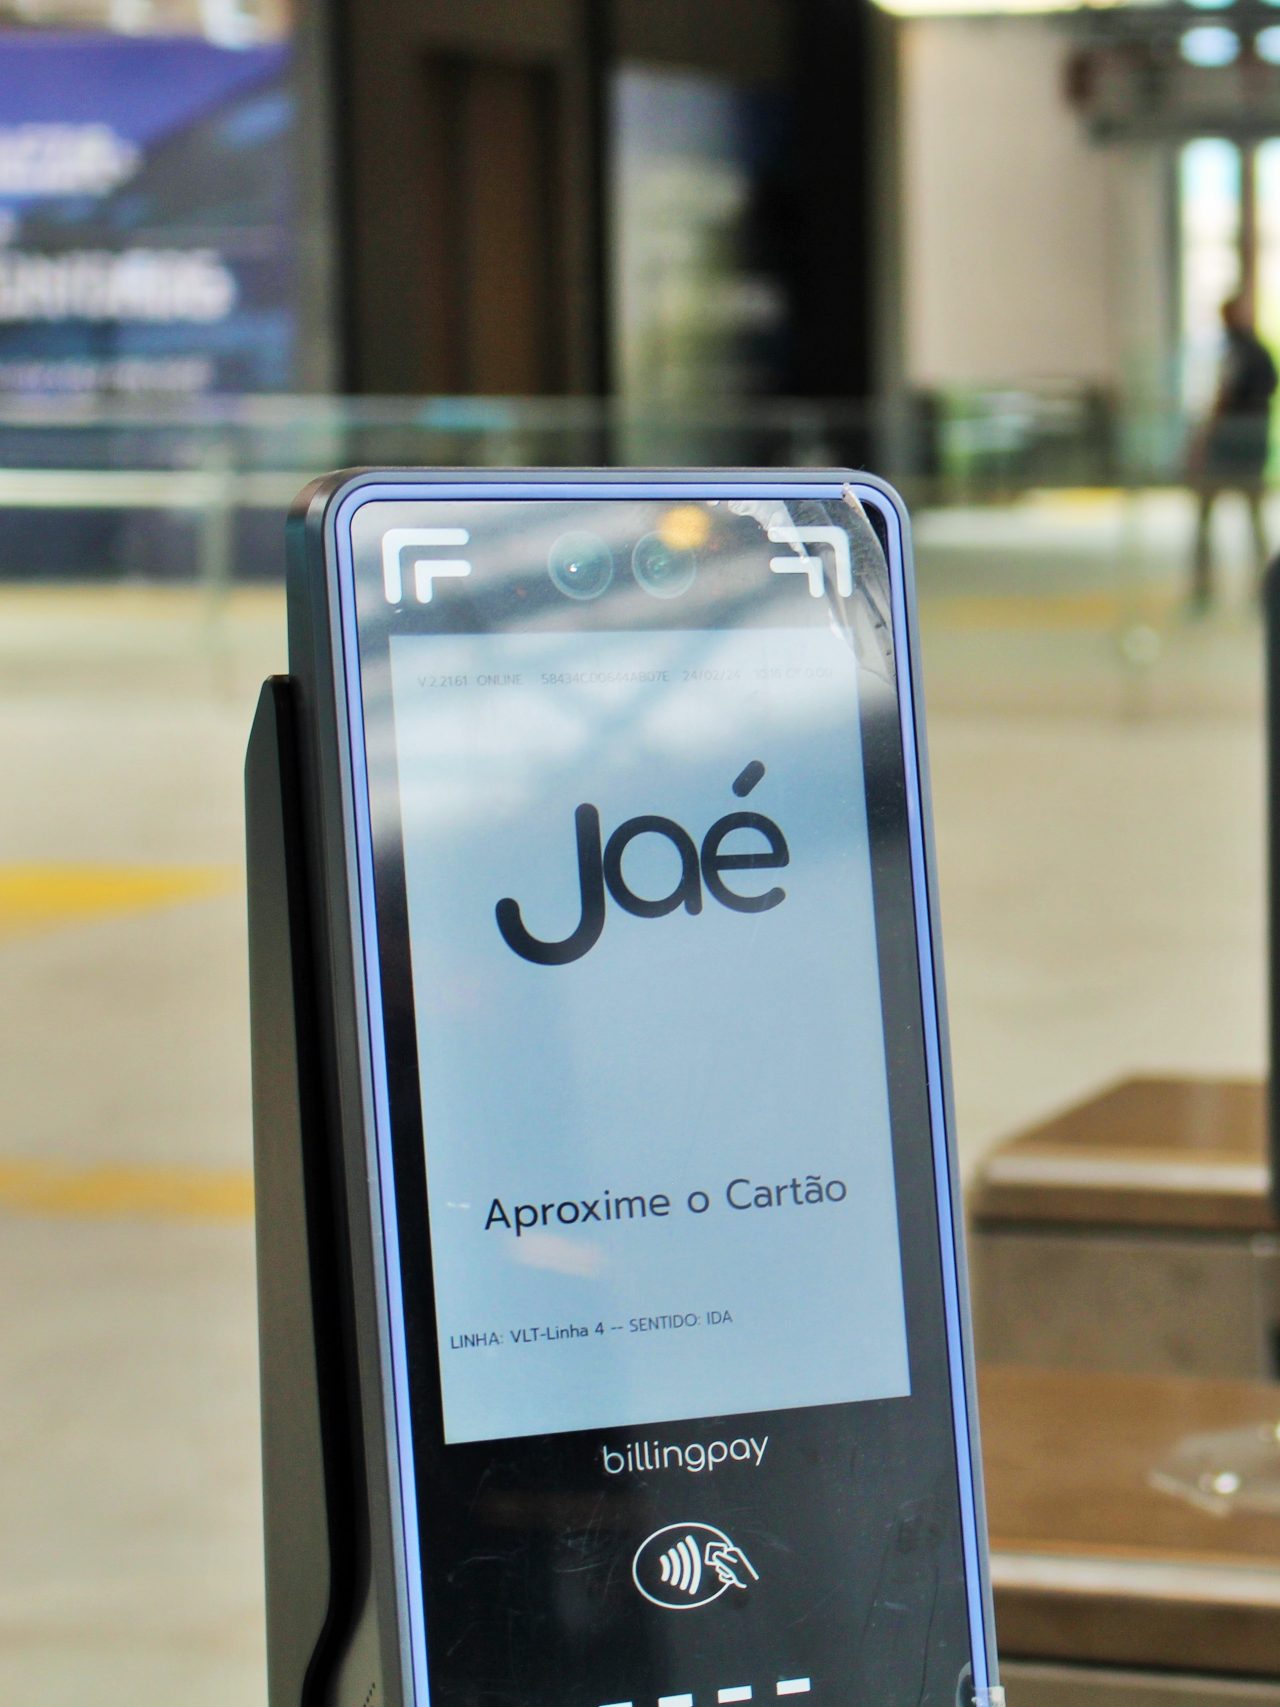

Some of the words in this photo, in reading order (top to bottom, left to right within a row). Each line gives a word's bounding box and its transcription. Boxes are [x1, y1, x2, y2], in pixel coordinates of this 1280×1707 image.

[476, 672, 523, 686] ONLINE
[496, 760, 789, 965] Jaé
[485, 1189, 670, 1236] Aproxime
[687, 1191, 710, 1213] o
[726, 1174, 847, 1209] Cartão
[450, 1331, 504, 1349] LINHA:
[510, 1325, 589, 1344] VLT-Linha
[595, 1321, 604, 1336] 4
[629, 1313, 701, 1333] SENTIDO:
[707, 1309, 733, 1325] IDA
[602, 1435, 768, 1474] billingpay
